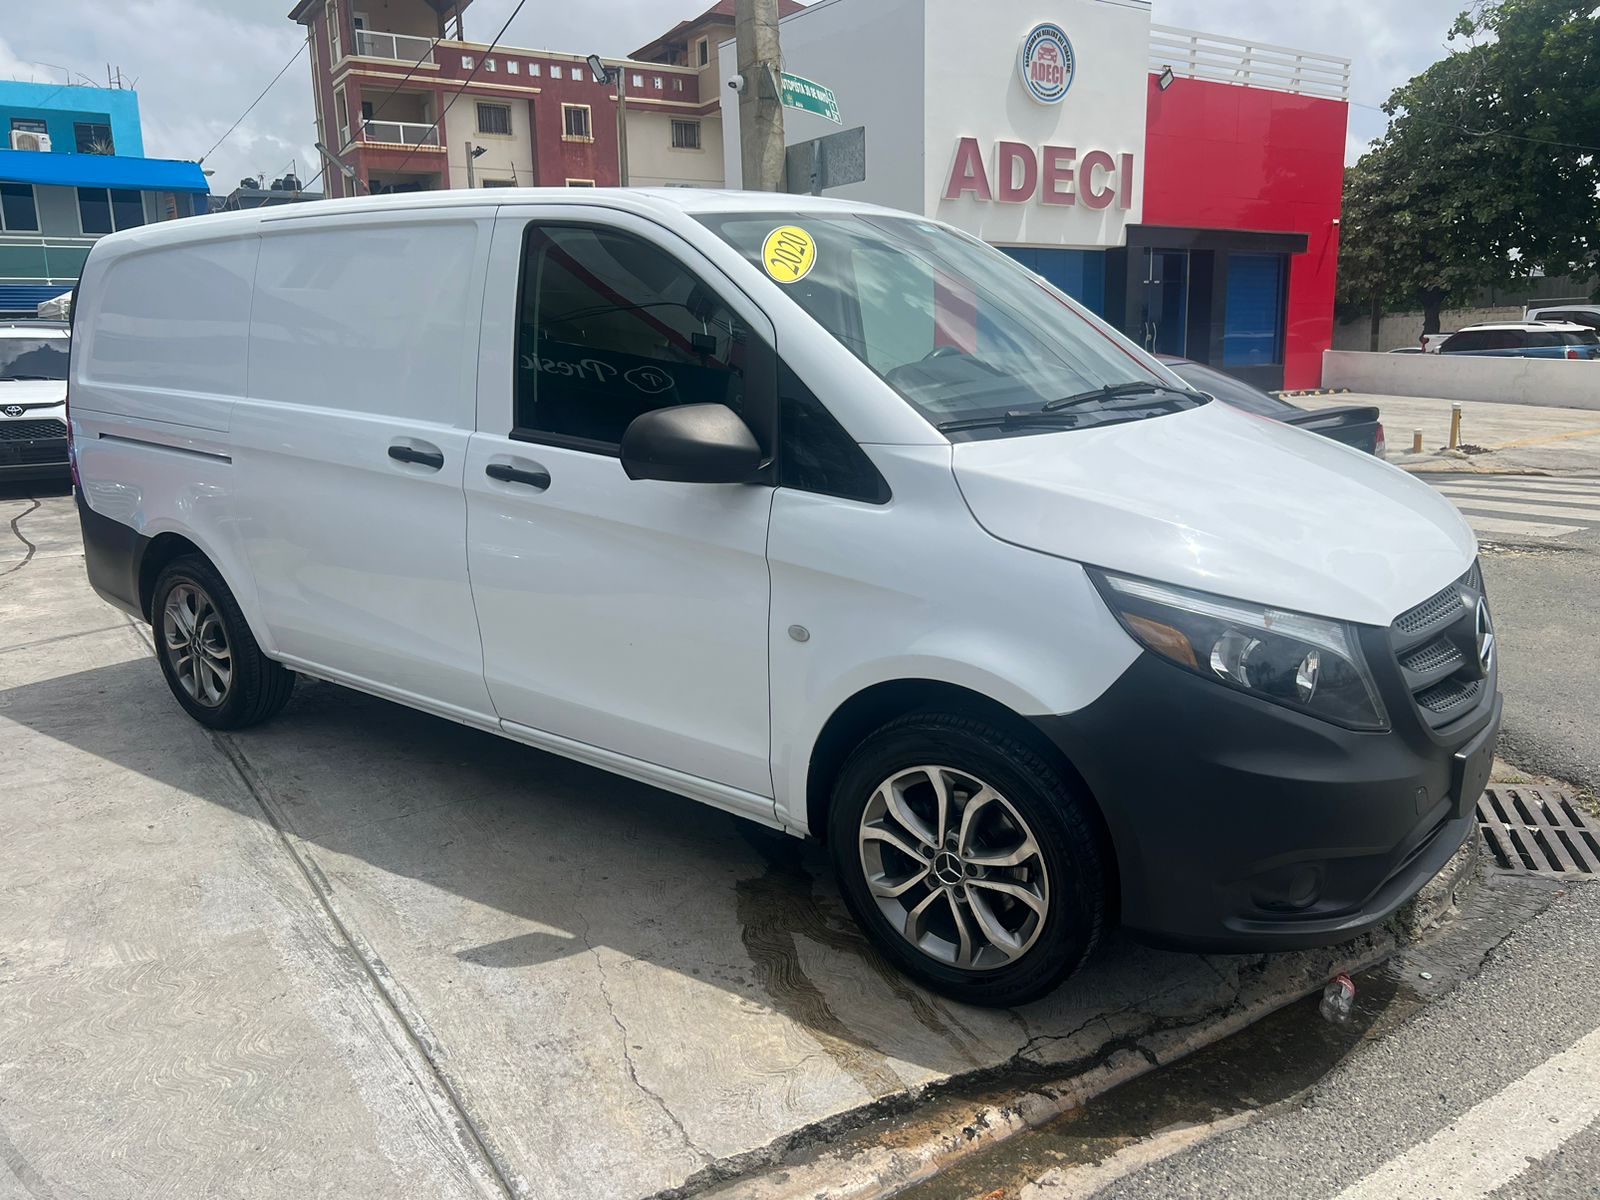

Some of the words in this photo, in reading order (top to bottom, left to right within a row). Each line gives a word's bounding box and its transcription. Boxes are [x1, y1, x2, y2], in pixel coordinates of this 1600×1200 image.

[1030, 61, 1064, 85] ADECI
[942, 136, 1134, 210] ADECI
[770, 231, 808, 276] 2020
